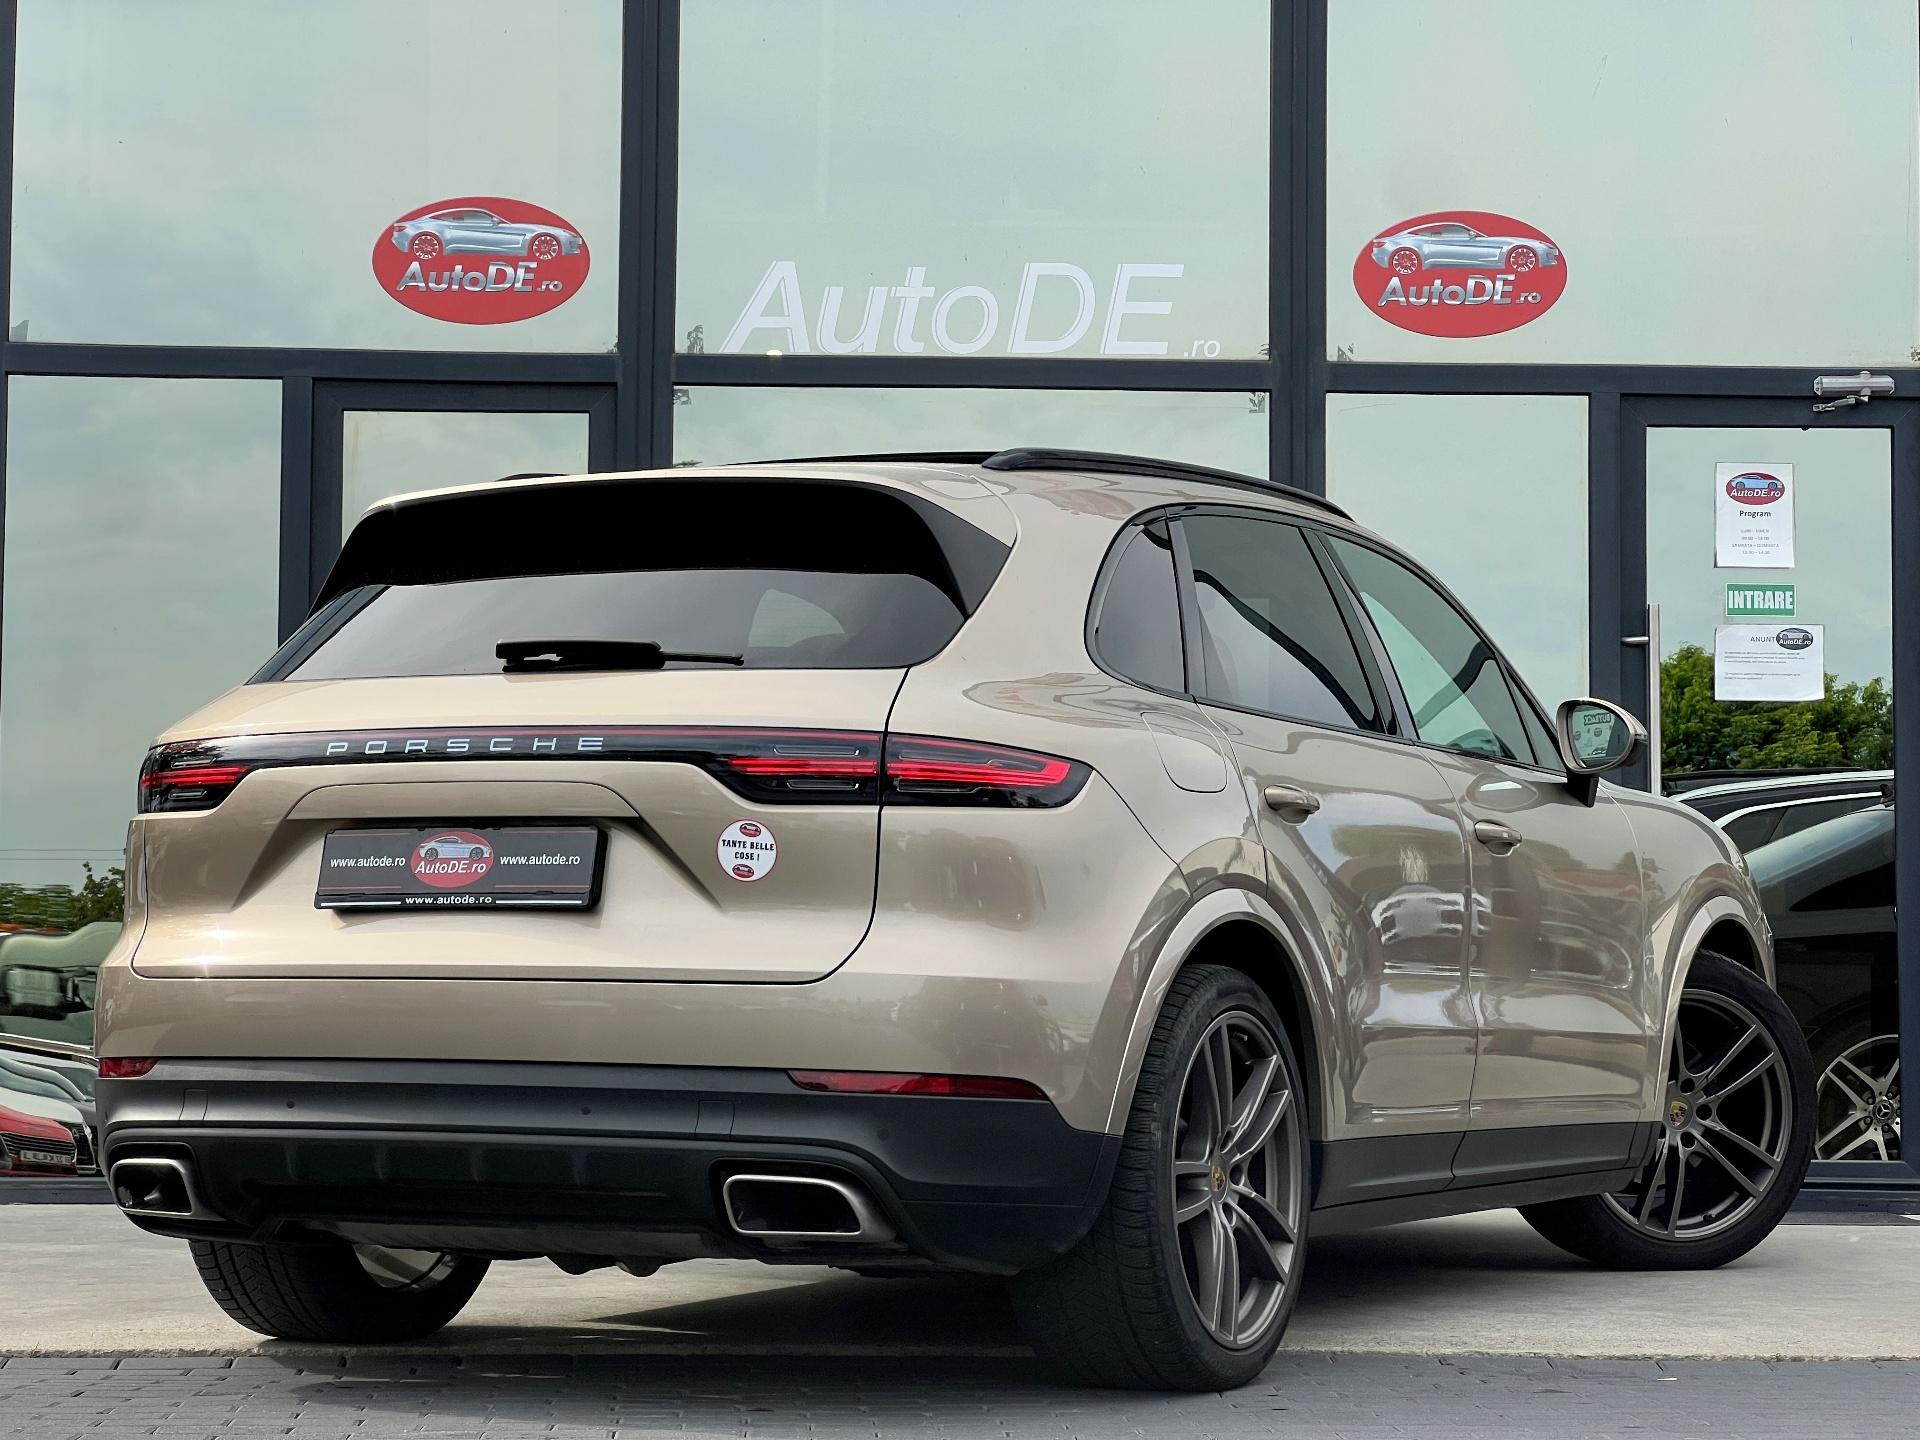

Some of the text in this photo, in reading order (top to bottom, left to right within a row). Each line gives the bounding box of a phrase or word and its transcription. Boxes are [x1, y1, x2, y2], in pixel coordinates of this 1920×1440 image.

[396, 261, 563, 292] AutoDE.ro
[1377, 274, 1541, 307] AutoDE.ro
[1730, 489, 1781, 497] AutoDE.ro
[1739, 510, 1771, 518] Program
[1728, 590, 1794, 609] INTRARE
[326, 737, 604, 756] PORSCHE
[722, 839, 774, 851] TANTE BELLE
[330, 856, 406, 868] www.autode.ro
[500, 853, 580, 865] www.autode.ro
[734, 852, 754, 860] COSE
[414, 860, 486, 874] AutoDE.ro
[405, 895, 492, 905] www.autode.ro
